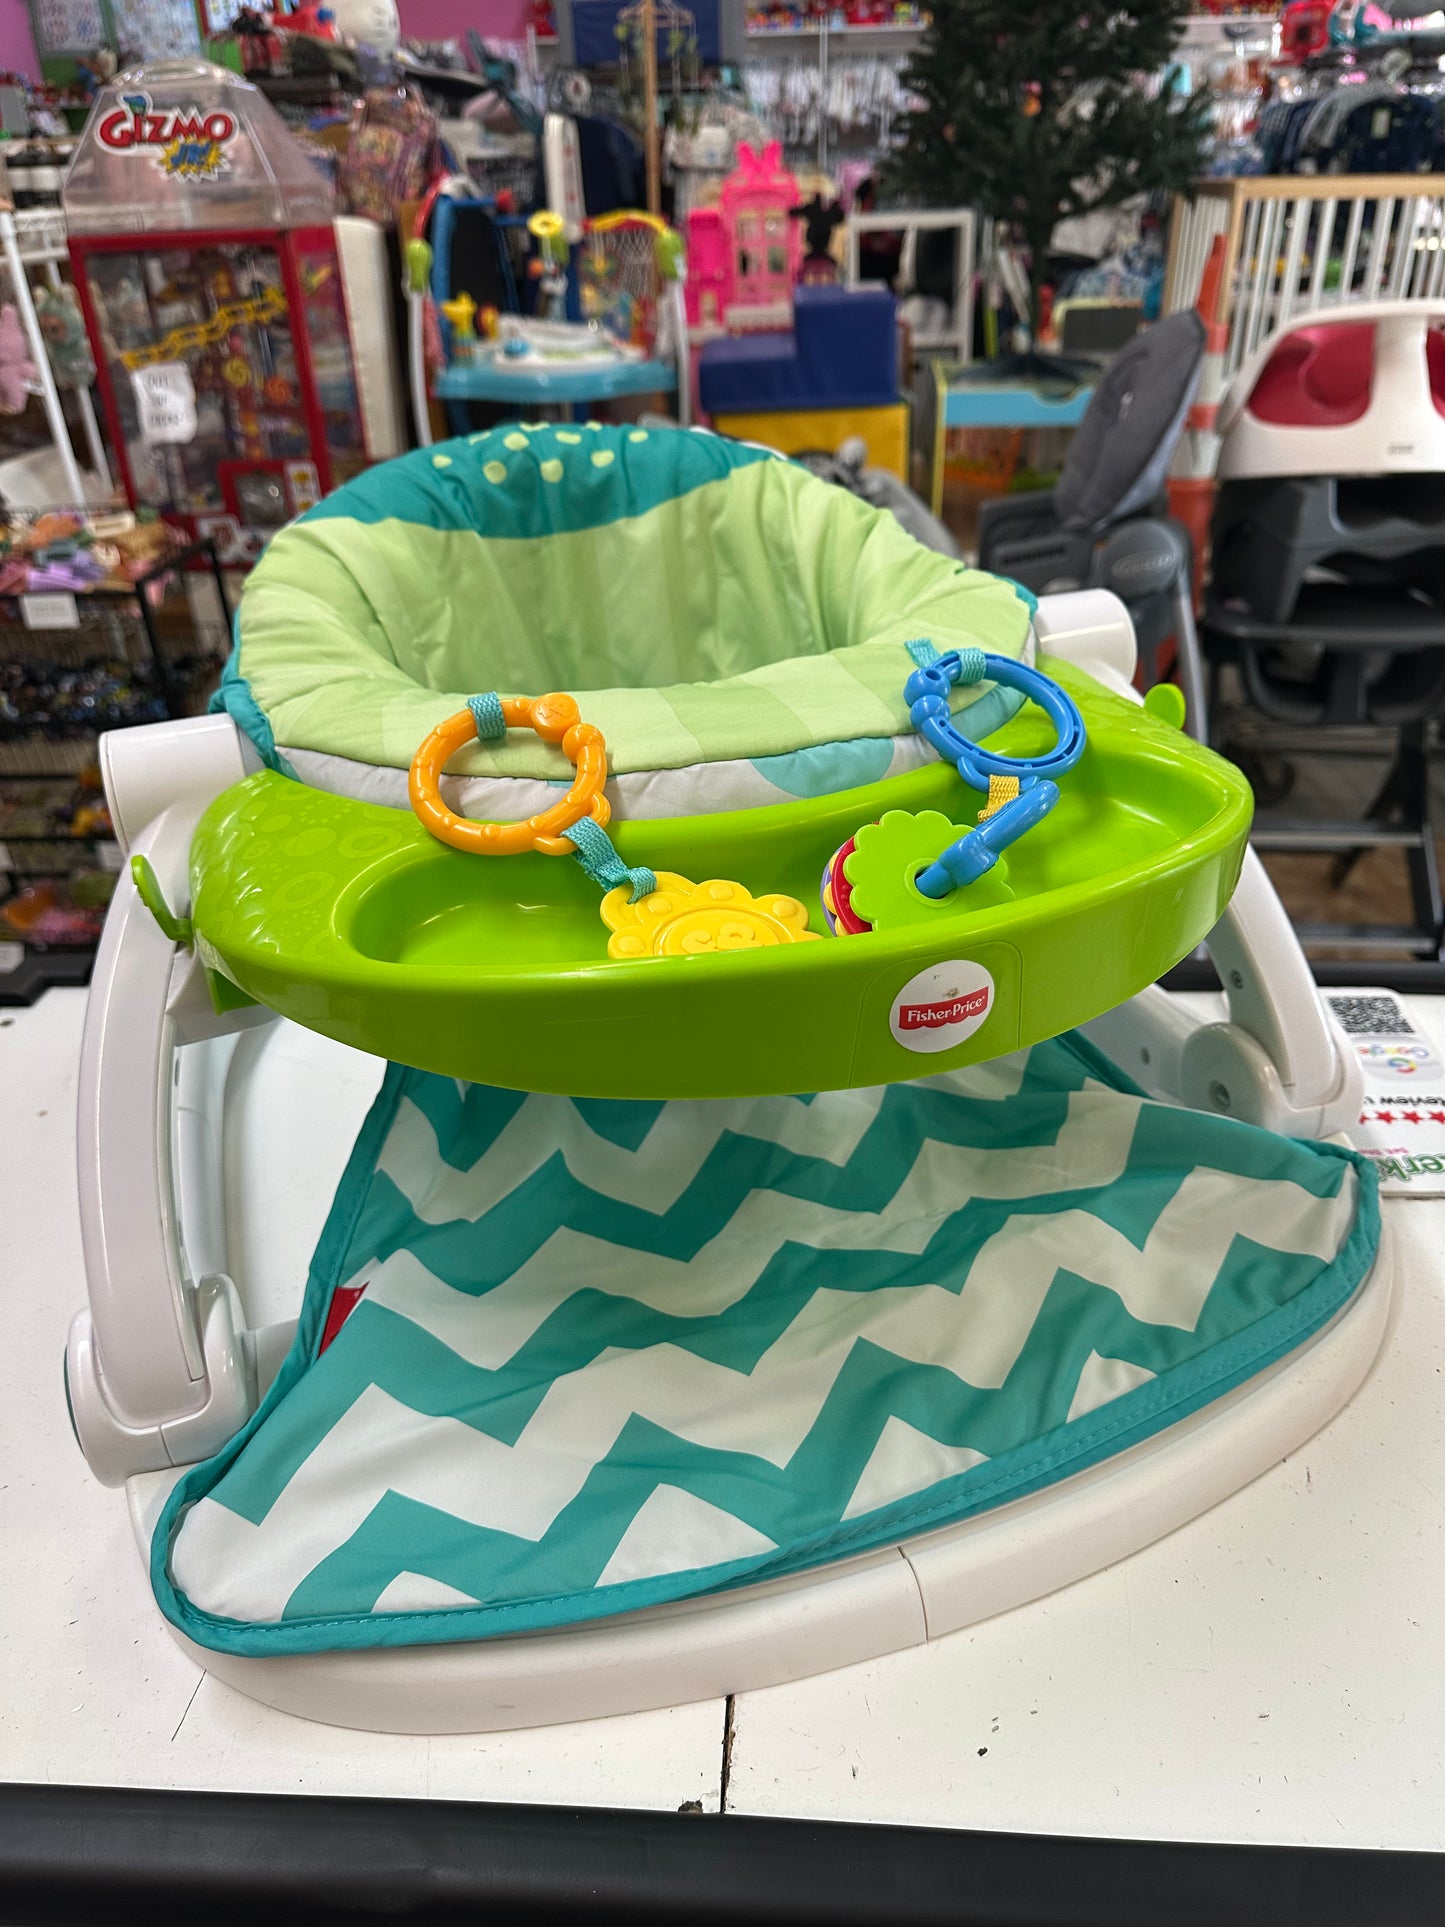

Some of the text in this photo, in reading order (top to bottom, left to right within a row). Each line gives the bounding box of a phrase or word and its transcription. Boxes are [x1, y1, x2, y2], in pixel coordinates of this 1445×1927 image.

[99, 105, 234, 147] GIZMO
[907, 997, 983, 1022] Fisher-Price
[1358, 1045, 1429, 1058] Google
